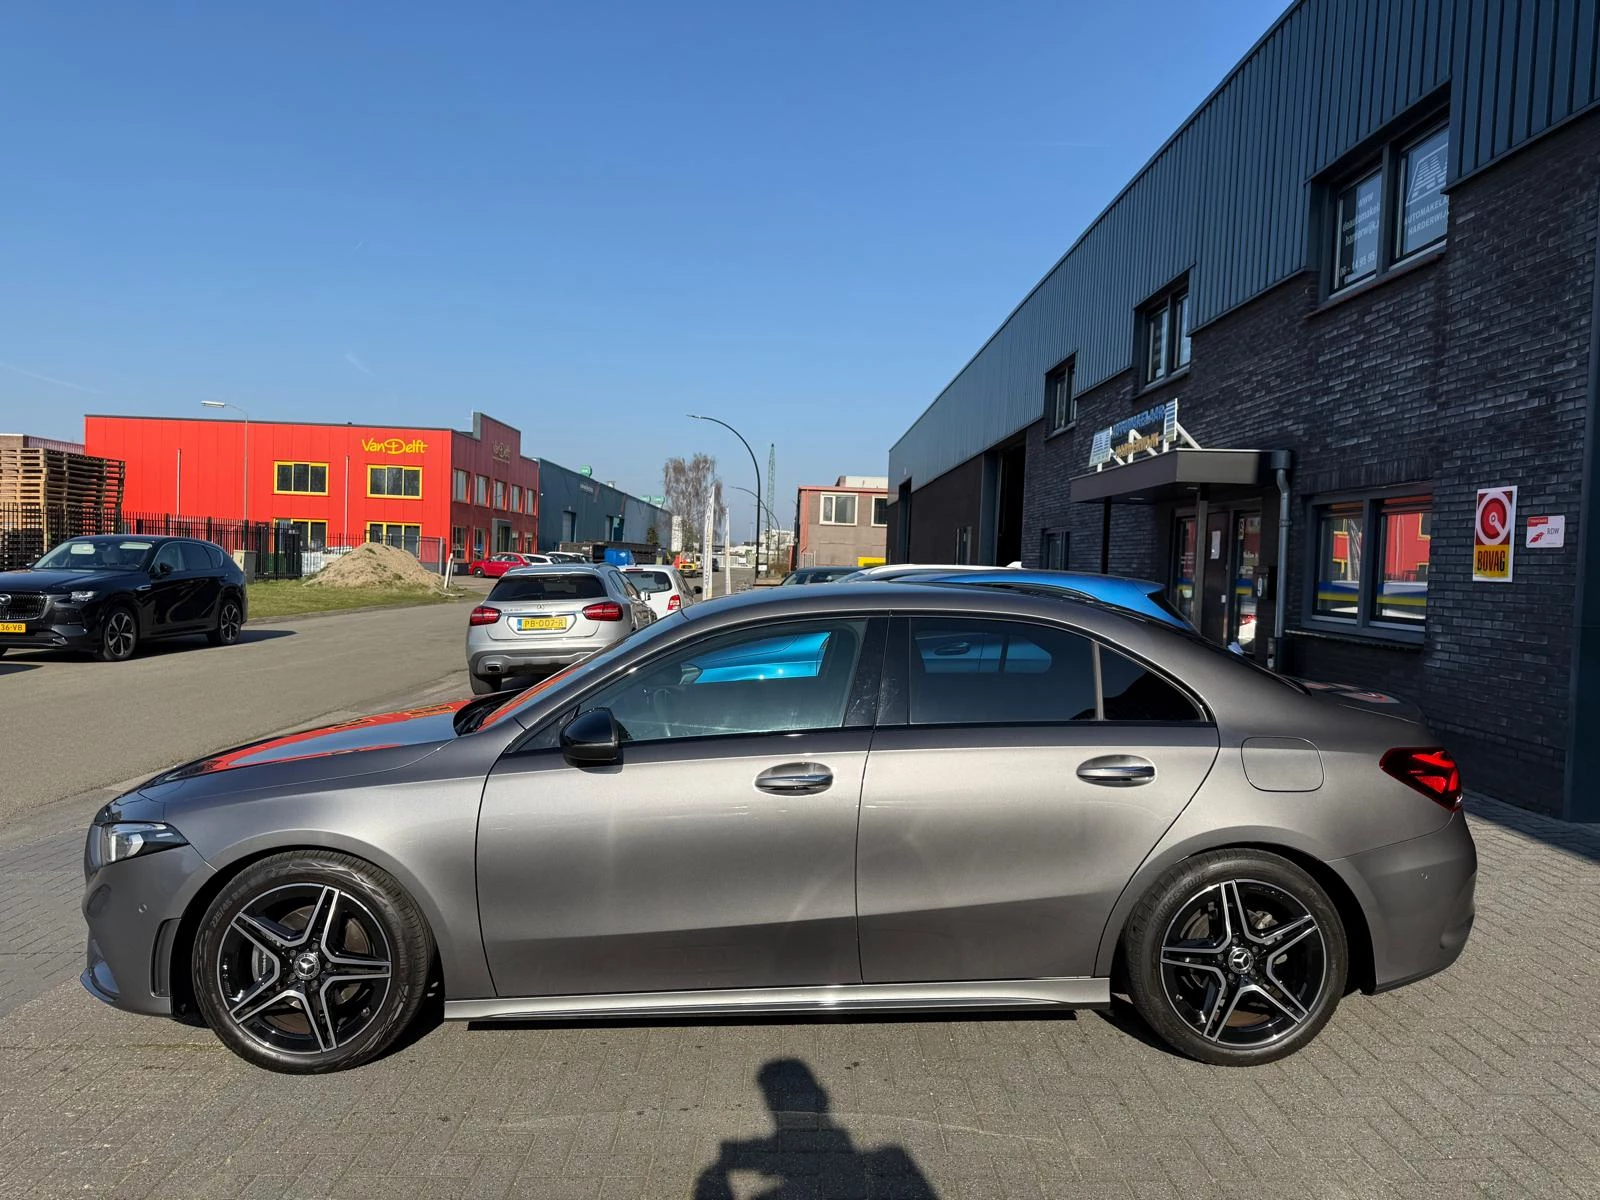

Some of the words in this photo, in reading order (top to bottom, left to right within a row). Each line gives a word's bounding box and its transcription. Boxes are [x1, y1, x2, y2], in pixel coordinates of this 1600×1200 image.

[1405, 194, 1449, 225] AUTOMAKELA
[1408, 208, 1449, 236] HARDERWIJ
[1546, 527, 1560, 535] RDW
[1477, 550, 1506, 572] BOVAG
